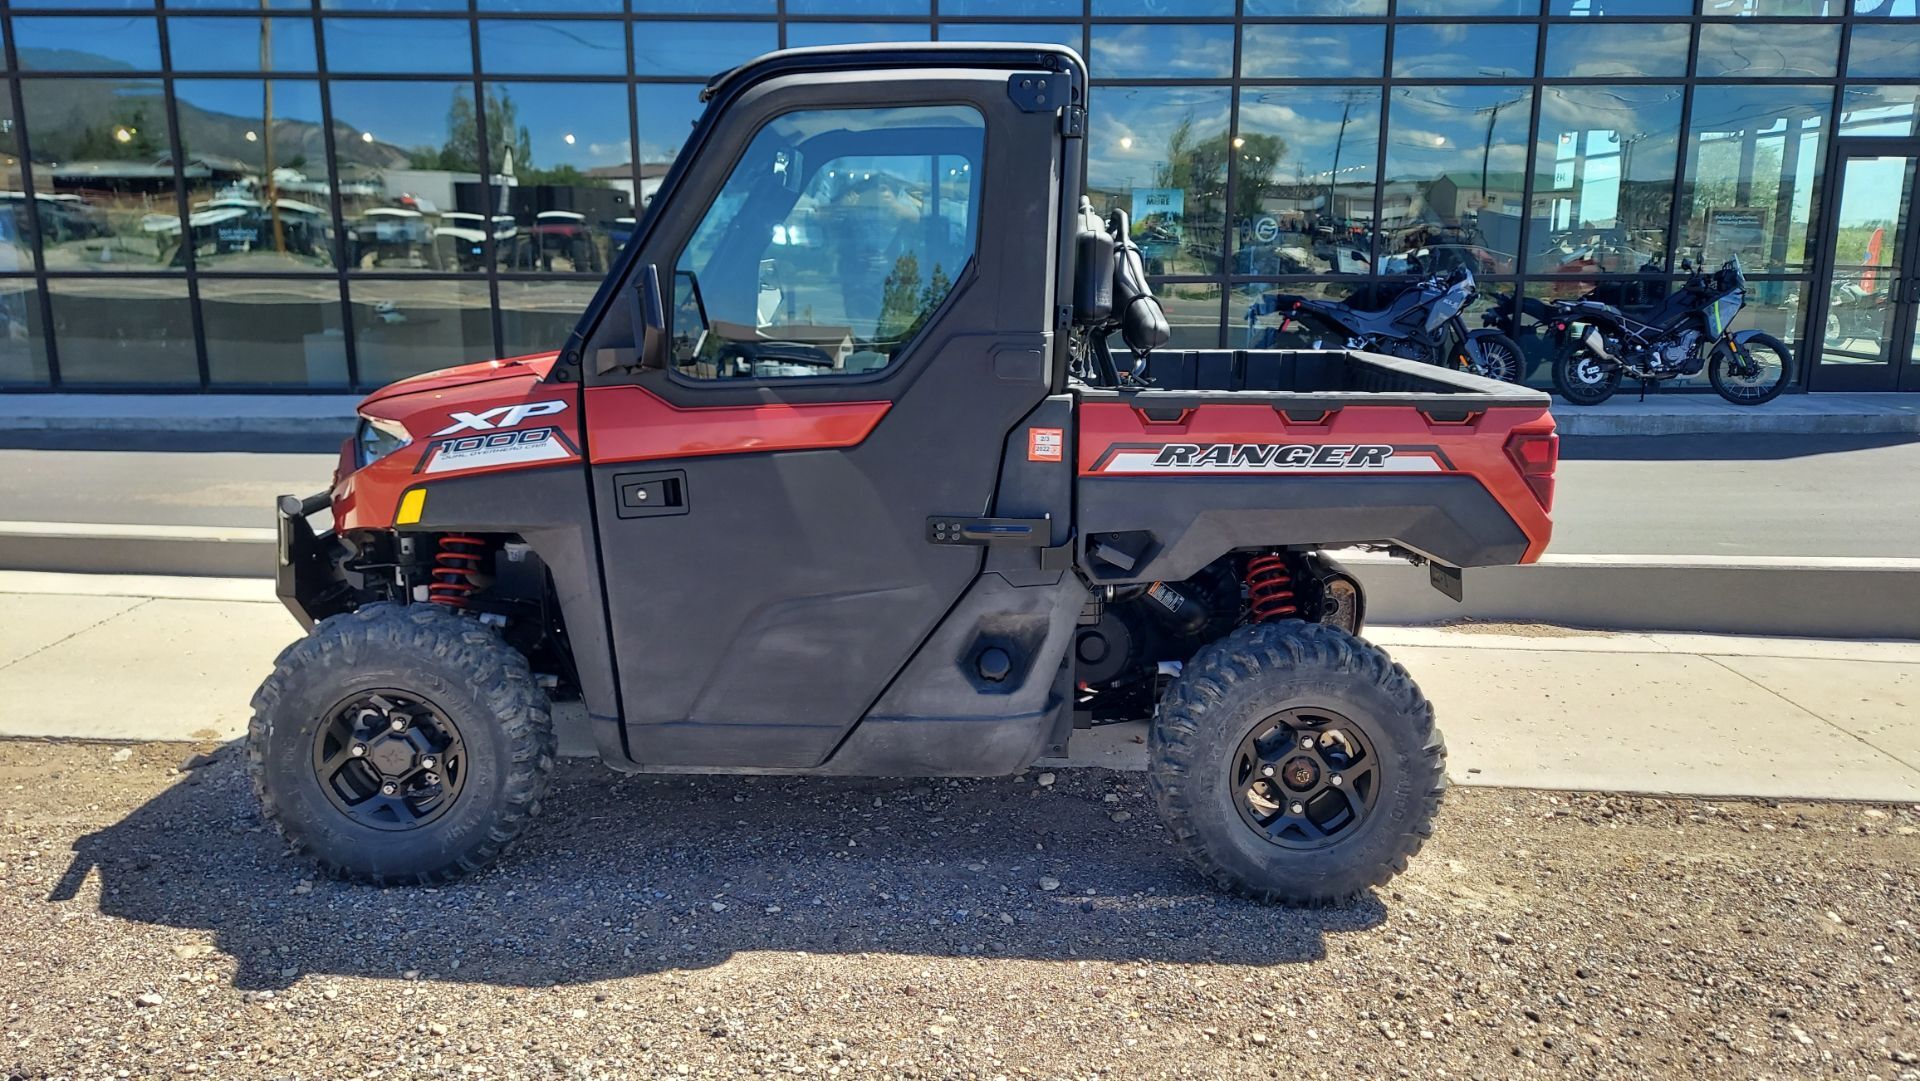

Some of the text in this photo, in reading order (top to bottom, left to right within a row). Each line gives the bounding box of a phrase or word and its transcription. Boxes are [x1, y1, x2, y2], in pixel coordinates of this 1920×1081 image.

[430, 399, 569, 437] XP
[441, 428, 552, 454] 1000
[1152, 443, 1393, 467] RANGER
